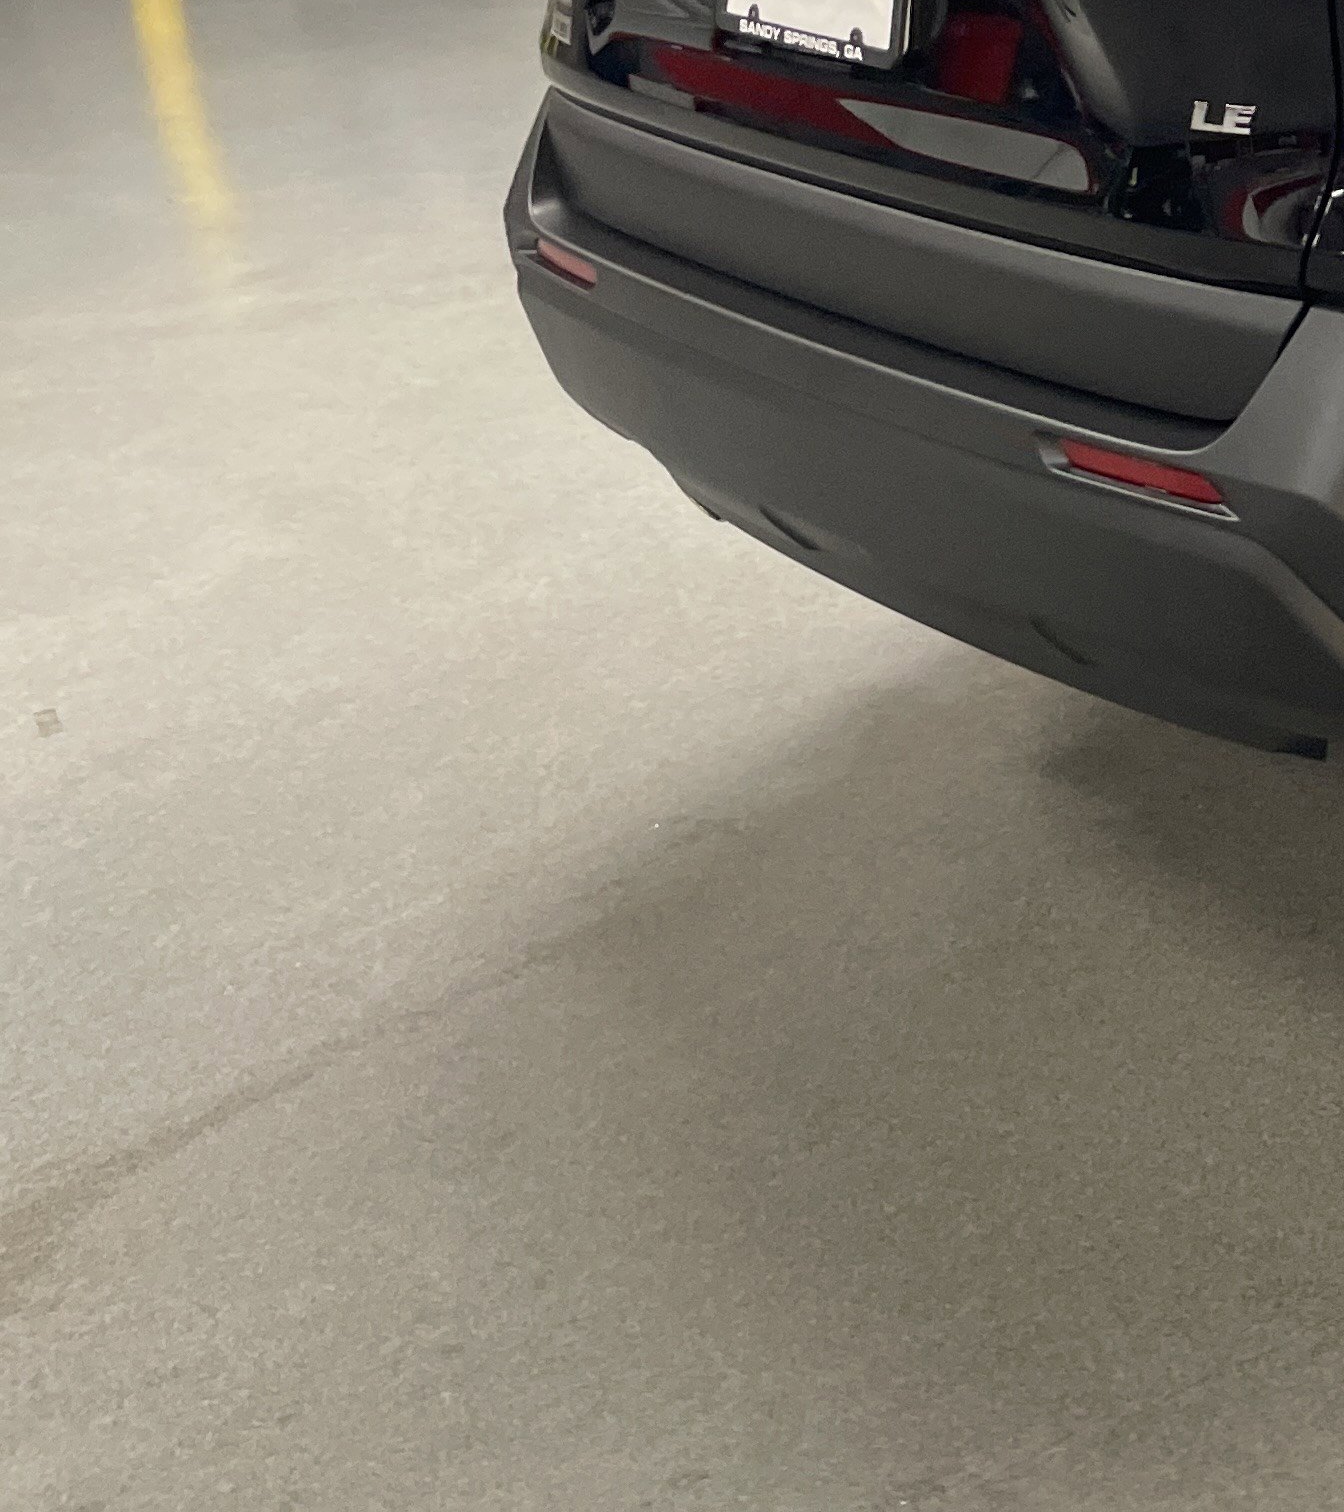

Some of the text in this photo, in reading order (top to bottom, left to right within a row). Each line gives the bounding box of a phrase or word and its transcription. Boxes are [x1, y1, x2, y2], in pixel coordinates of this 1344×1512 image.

[738, 18, 781, 41] SANDY
[843, 44, 863, 61] GA
[1190, 100, 1256, 136] LE
